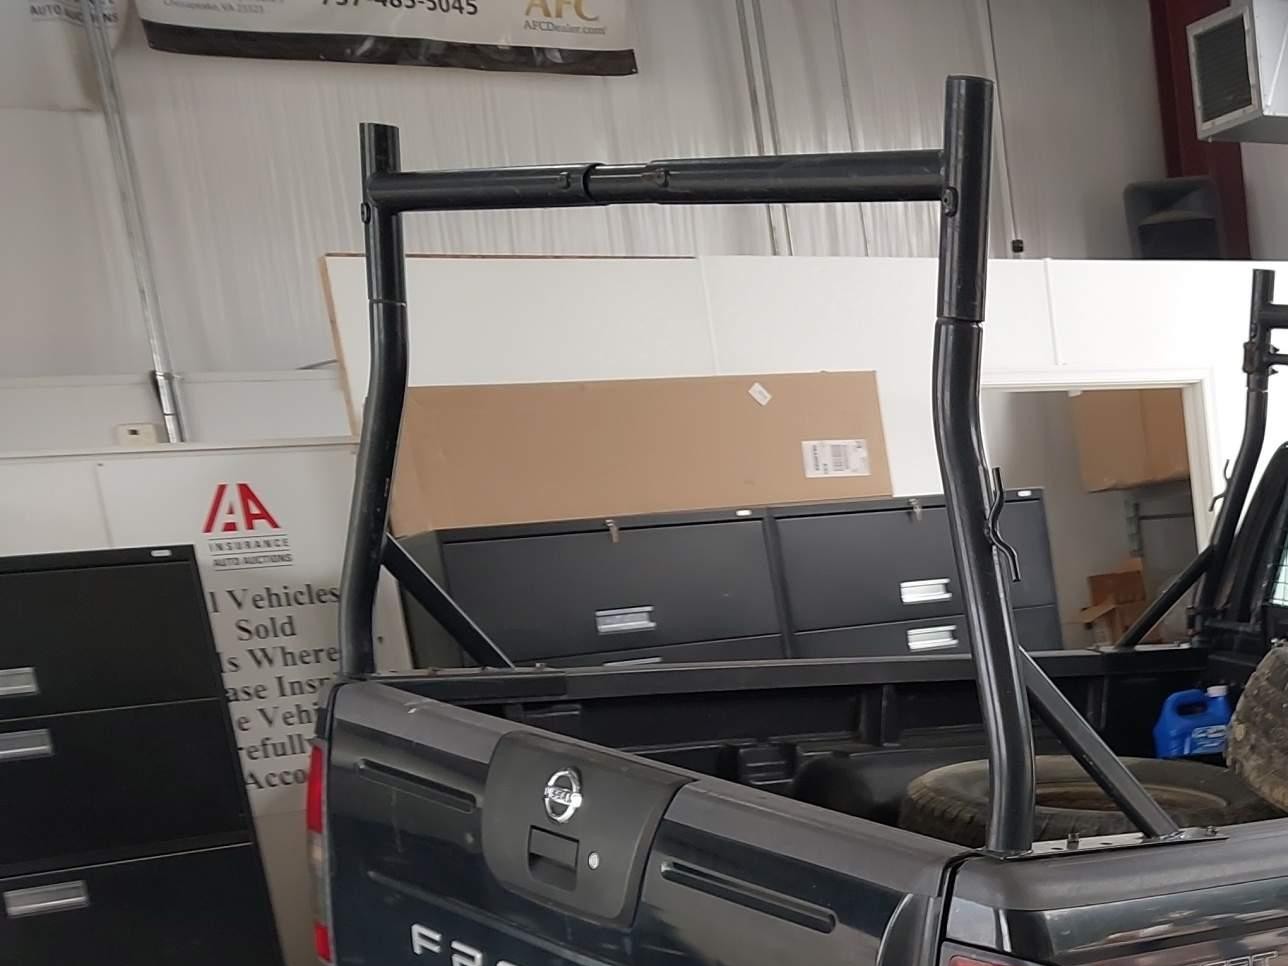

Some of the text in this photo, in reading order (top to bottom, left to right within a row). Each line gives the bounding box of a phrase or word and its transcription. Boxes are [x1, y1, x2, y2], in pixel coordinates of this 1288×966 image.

[30, 5, 61, 16] AUTO
[208, 539, 290, 553] INSURANCE
[213, 554, 293, 567] AUTO AUCTIONS
[225, 583, 341, 611] Vehicles
[235, 615, 297, 641] Sold
[246, 645, 341, 668] Where
